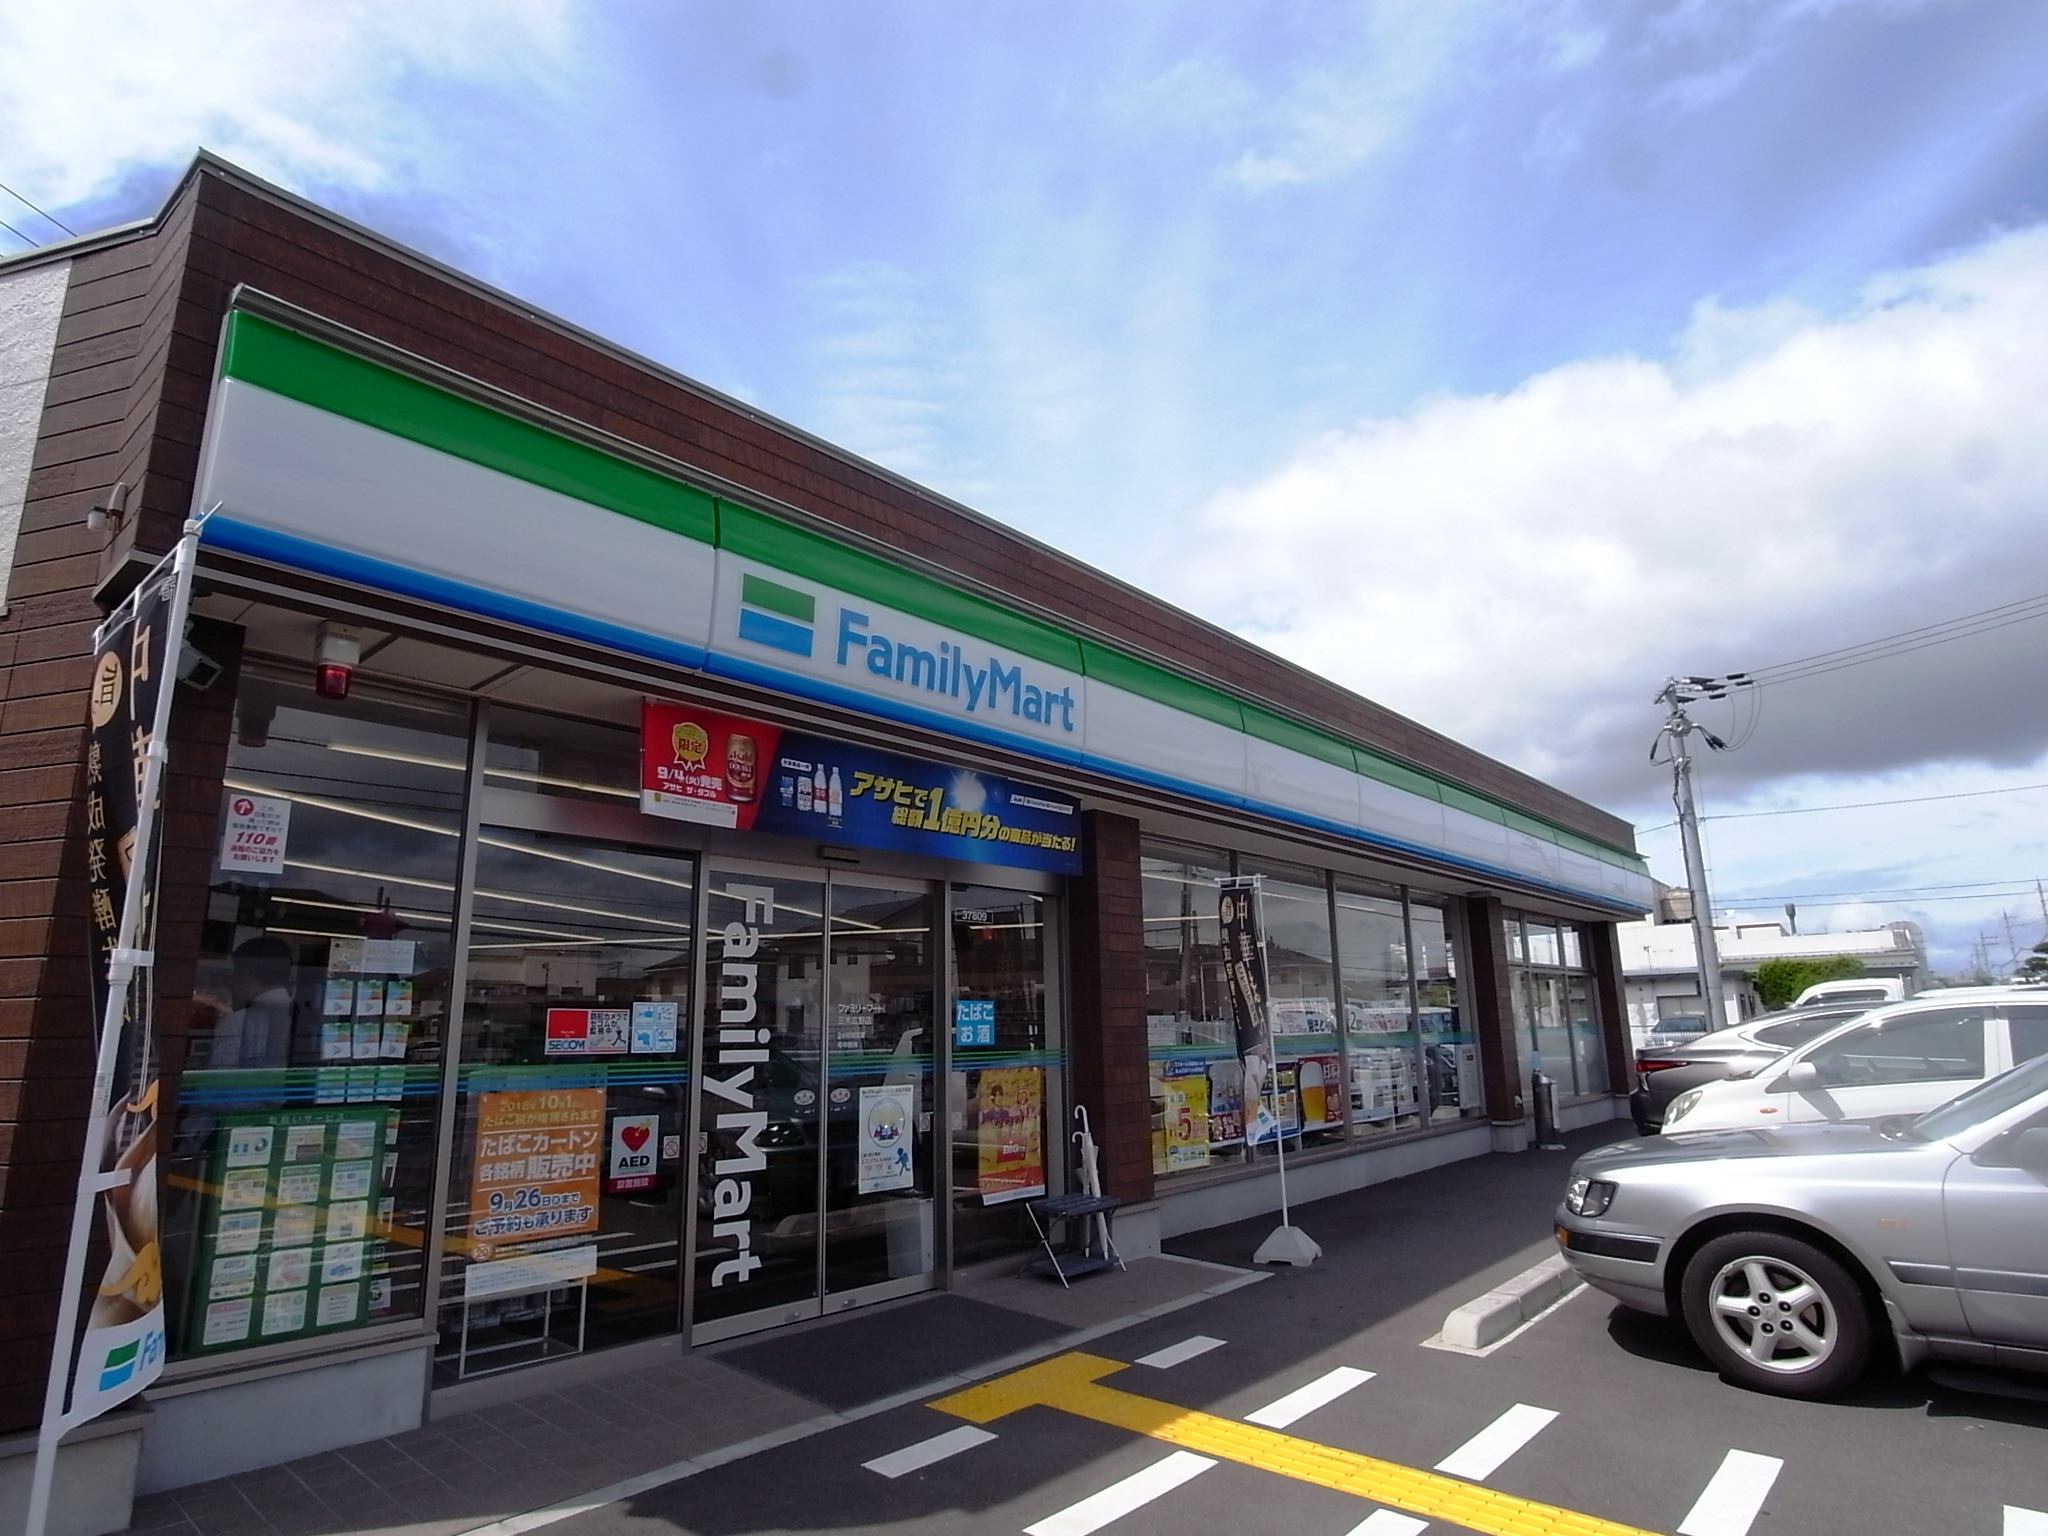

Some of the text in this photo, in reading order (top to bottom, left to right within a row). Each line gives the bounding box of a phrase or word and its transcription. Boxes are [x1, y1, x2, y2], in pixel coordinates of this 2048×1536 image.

[836, 607, 1074, 732] FamilyMart
[679, 738, 702, 754] 限定
[850, 771, 928, 808] アサヒで
[236, 831, 278, 846] 110番
[962, 910, 988, 922] 37809
[957, 1003, 994, 1021] たばこ
[960, 1024, 990, 1043] お酒
[548, 1039, 585, 1050] SECOM
[702, 883, 774, 1288] FamilyMart
[480, 1130, 598, 1157] たばこカートン
[618, 1155, 651, 1169] AED
[474, 1207, 593, 1236] ご予約も承ります
